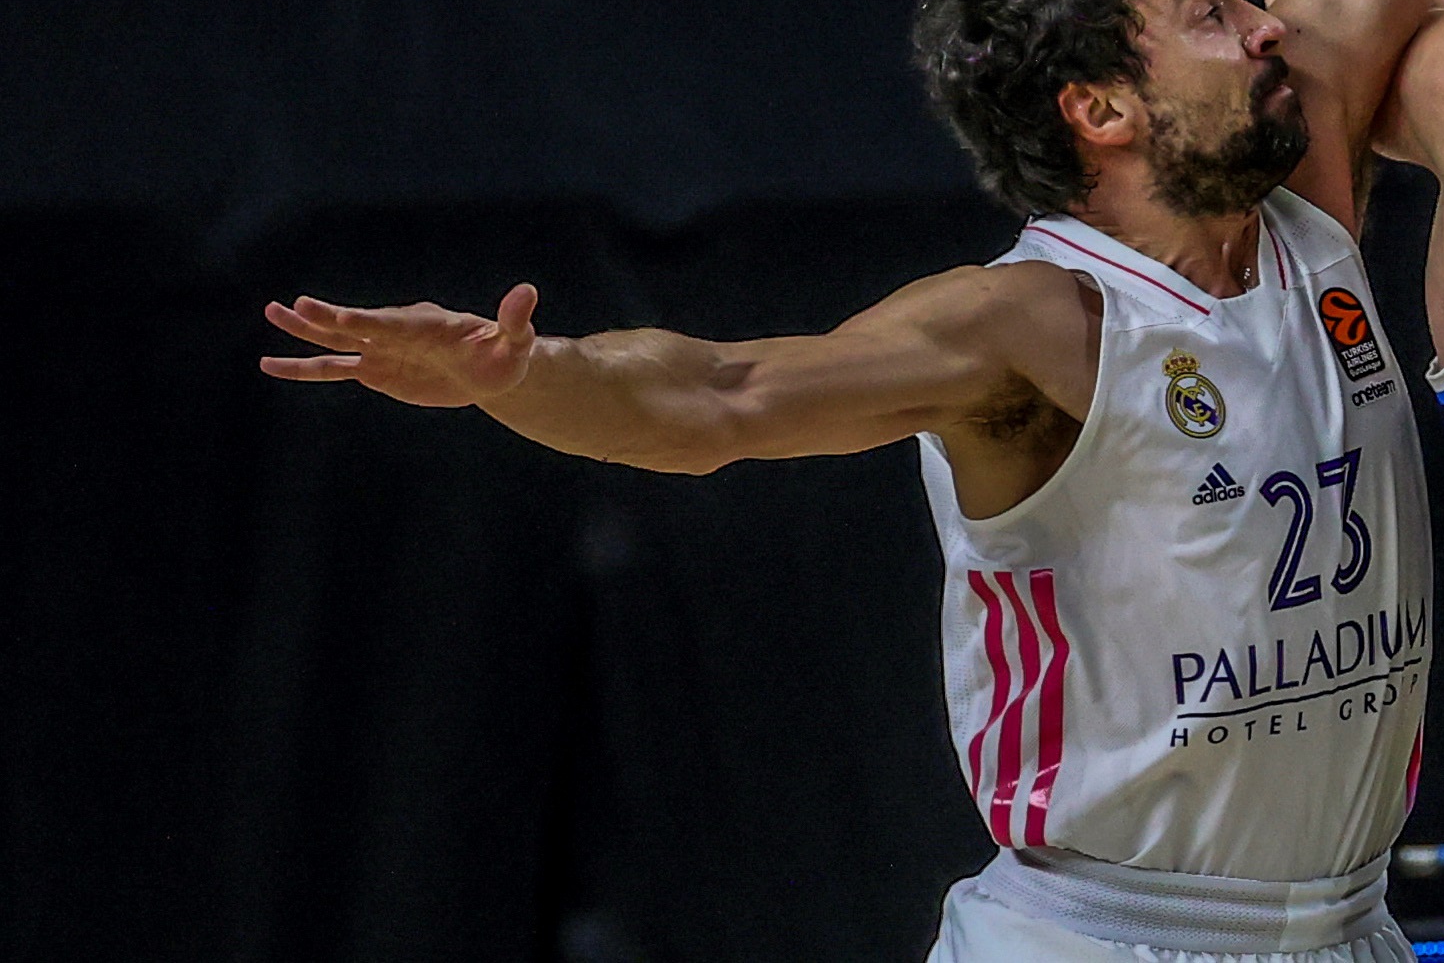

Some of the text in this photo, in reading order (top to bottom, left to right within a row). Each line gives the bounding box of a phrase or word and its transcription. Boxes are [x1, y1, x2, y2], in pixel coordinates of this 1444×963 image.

[1341, 340, 1375, 359] TURKISH
[1192, 485, 1245, 506] adidas
[1259, 447, 1372, 612] 23
[1172, 597, 1426, 705] PALLADIUM
[1170, 673, 1418, 747] HOTEL GROP
